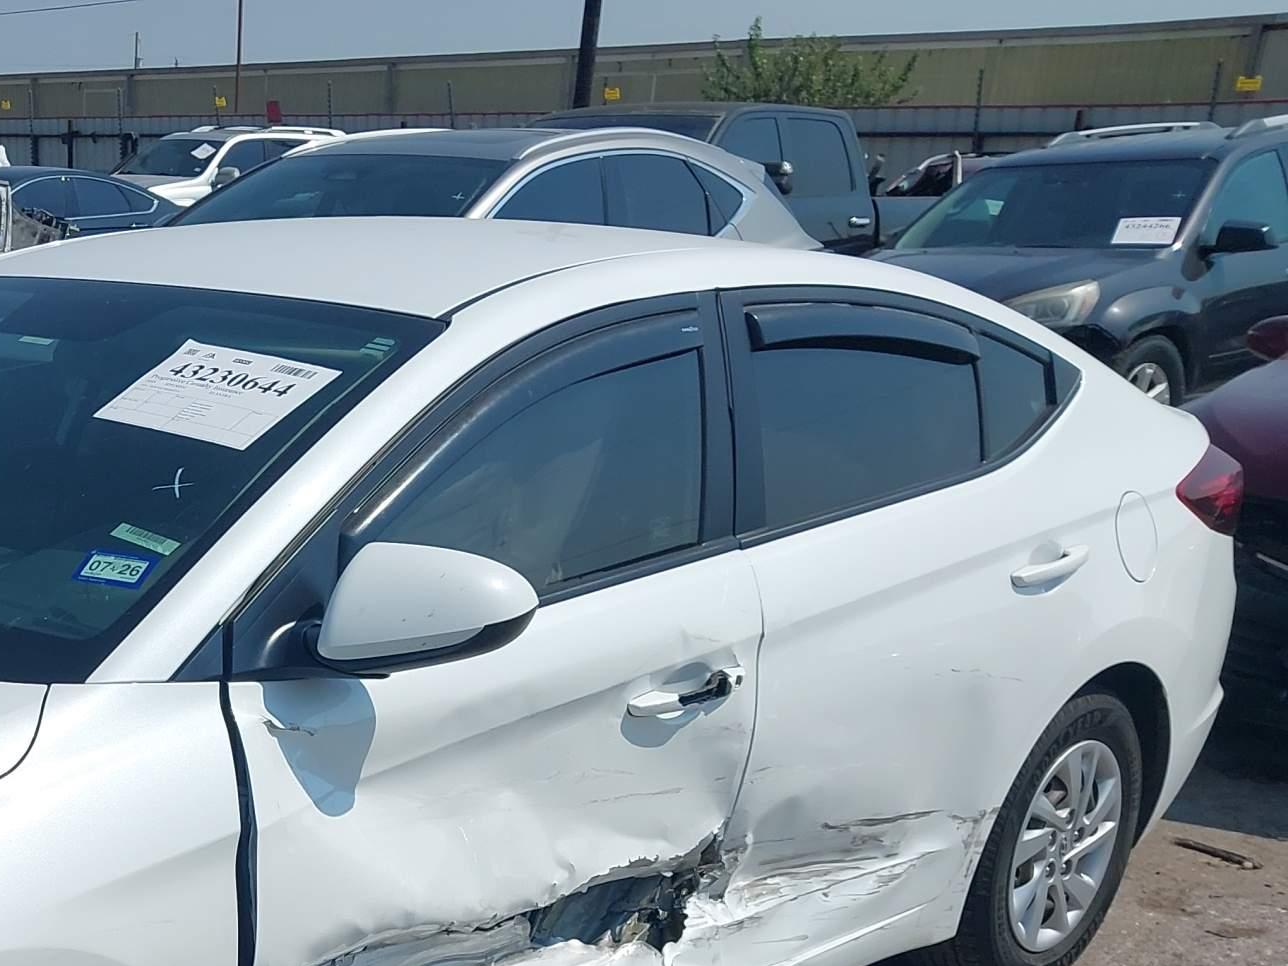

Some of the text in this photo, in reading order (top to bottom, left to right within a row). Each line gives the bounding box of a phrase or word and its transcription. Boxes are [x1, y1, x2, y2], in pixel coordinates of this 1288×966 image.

[169, 361, 298, 398] 43230644
[89, 560, 143, 577] 07 26
